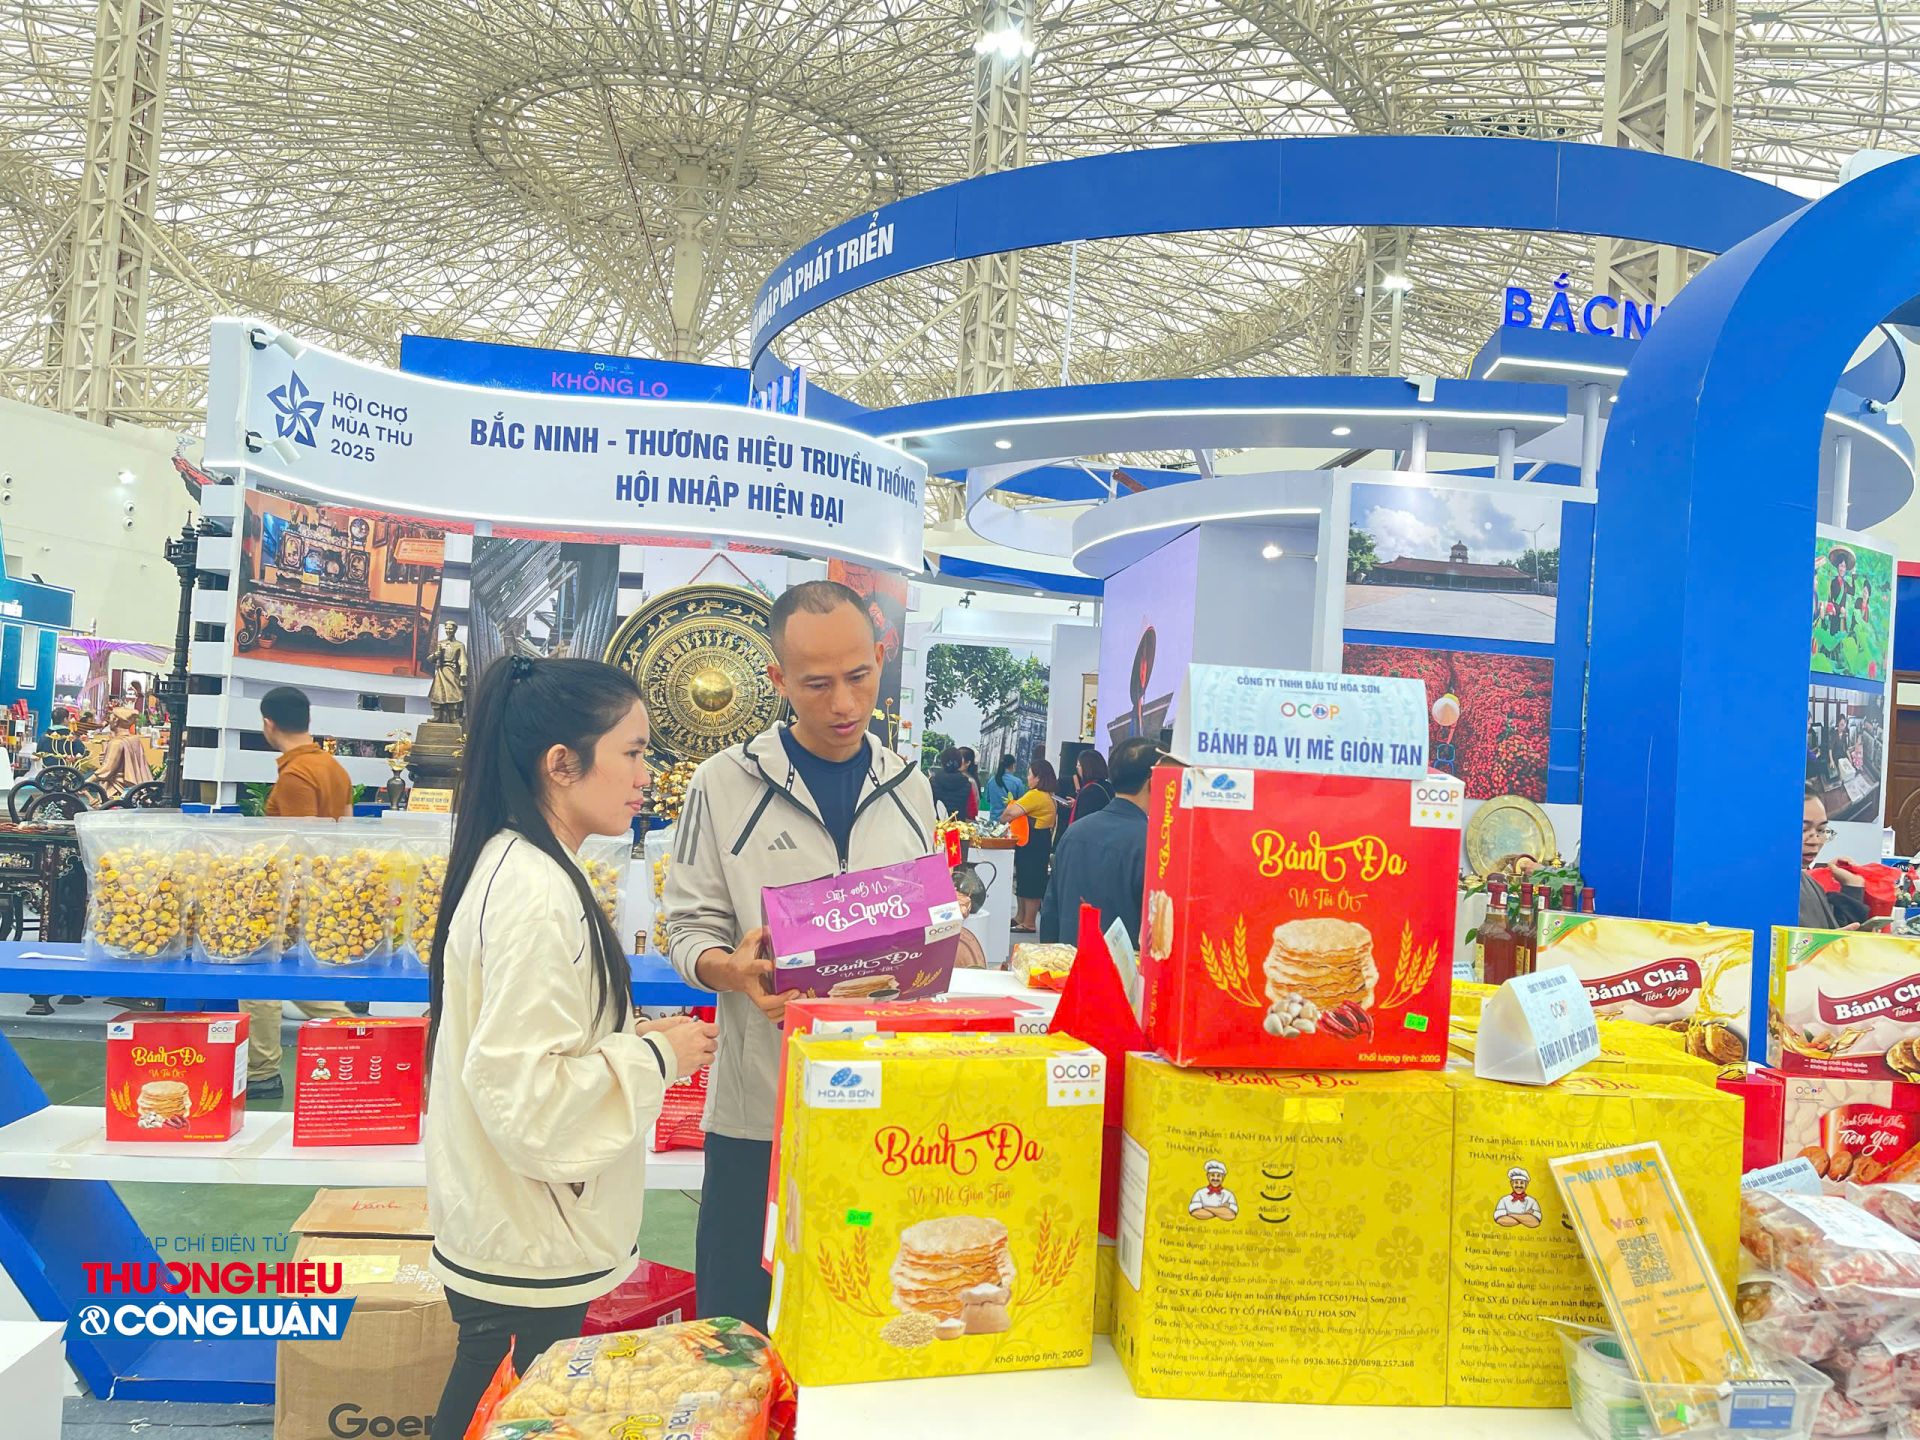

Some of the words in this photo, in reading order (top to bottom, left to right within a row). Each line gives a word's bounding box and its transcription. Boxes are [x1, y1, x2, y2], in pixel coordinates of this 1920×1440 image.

[780, 267, 794, 309] VÀ
[795, 245, 834, 301] PHÁT
[837, 211, 895, 274] TRIỂN
[551, 370, 634, 395] KHÔNG
[333, 391, 362, 413] HỘI
[367, 401, 408, 426] CHỢ
[332, 414, 370, 438] MÙA
[375, 425, 413, 446] THU
[331, 439, 375, 462] 2025
[470, 411, 525, 450] BẮC
[534, 424, 599, 453] NINH
[626, 428, 729, 461] THƯƠNG
[737, 435, 793, 472] HIỆU
[800, 446, 872, 488] TRUYỀN
[877, 466, 918, 509] THỐNG,
[616, 470, 659, 508] HỘI
[668, 475, 740, 512] NHẬP
[748, 482, 804, 519] HIỆN
[810, 493, 844, 527] ĐẠI
[1237, 675, 1263, 687] CÔNG
[1265, 678, 1276, 688] TY
[1279, 678, 1303, 689] TNHH
[1326, 681, 1338, 691] TƯ
[1361, 683, 1381, 694] SƠN
[1281, 702, 1340, 720] OCOP
[1198, 728, 1248, 756] BÁNH
[1253, 735, 1278, 757] ĐA
[1284, 737, 1301, 764] VỊ
[1307, 735, 1334, 761] MÈ
[1341, 737, 1383, 764] GIÒN
[1390, 743, 1423, 766] TAN
[1202, 791, 1224, 799] HOA
[1416, 788, 1459, 802] OCOP
[1251, 829, 1347, 882] Bánh
[1353, 835, 1407, 882] Đa
[812, 908, 849, 932] Đa
[849, 895, 911, 926] Bánh
[816, 959, 880, 977] Bánh
[886, 950, 922, 965] Đa
[1585, 978, 1641, 1002] Bánh
[1643, 964, 1689, 987] Chả
[1642, 991, 1664, 1002] Tiên
[1666, 986, 1690, 1000] Yên
[1834, 995, 1893, 1020] Bánh
[132, 1046, 177, 1067] Bánh
[180, 1047, 206, 1066] Đa
[1053, 1064, 1101, 1079] OCOP
[1203, 1068, 1300, 1089] Bánh
[1304, 1073, 1360, 1089] Đa
[818, 1089, 845, 1098] HOA
[848, 1088, 875, 1098] SƠN
[875, 1123, 977, 1176] Bánh
[986, 1122, 1044, 1171] Đa
[1838, 1129, 1866, 1144] Tiên
[1862, 1130, 1898, 1156] Yên
[1577, 1168, 1605, 1184] NAM
[1606, 1166, 1615, 1179] A
[1614, 1160, 1646, 1177] BANK
[1201, 1304, 1226, 1314] CÔNG
[1230, 1306, 1240, 1315] TY
